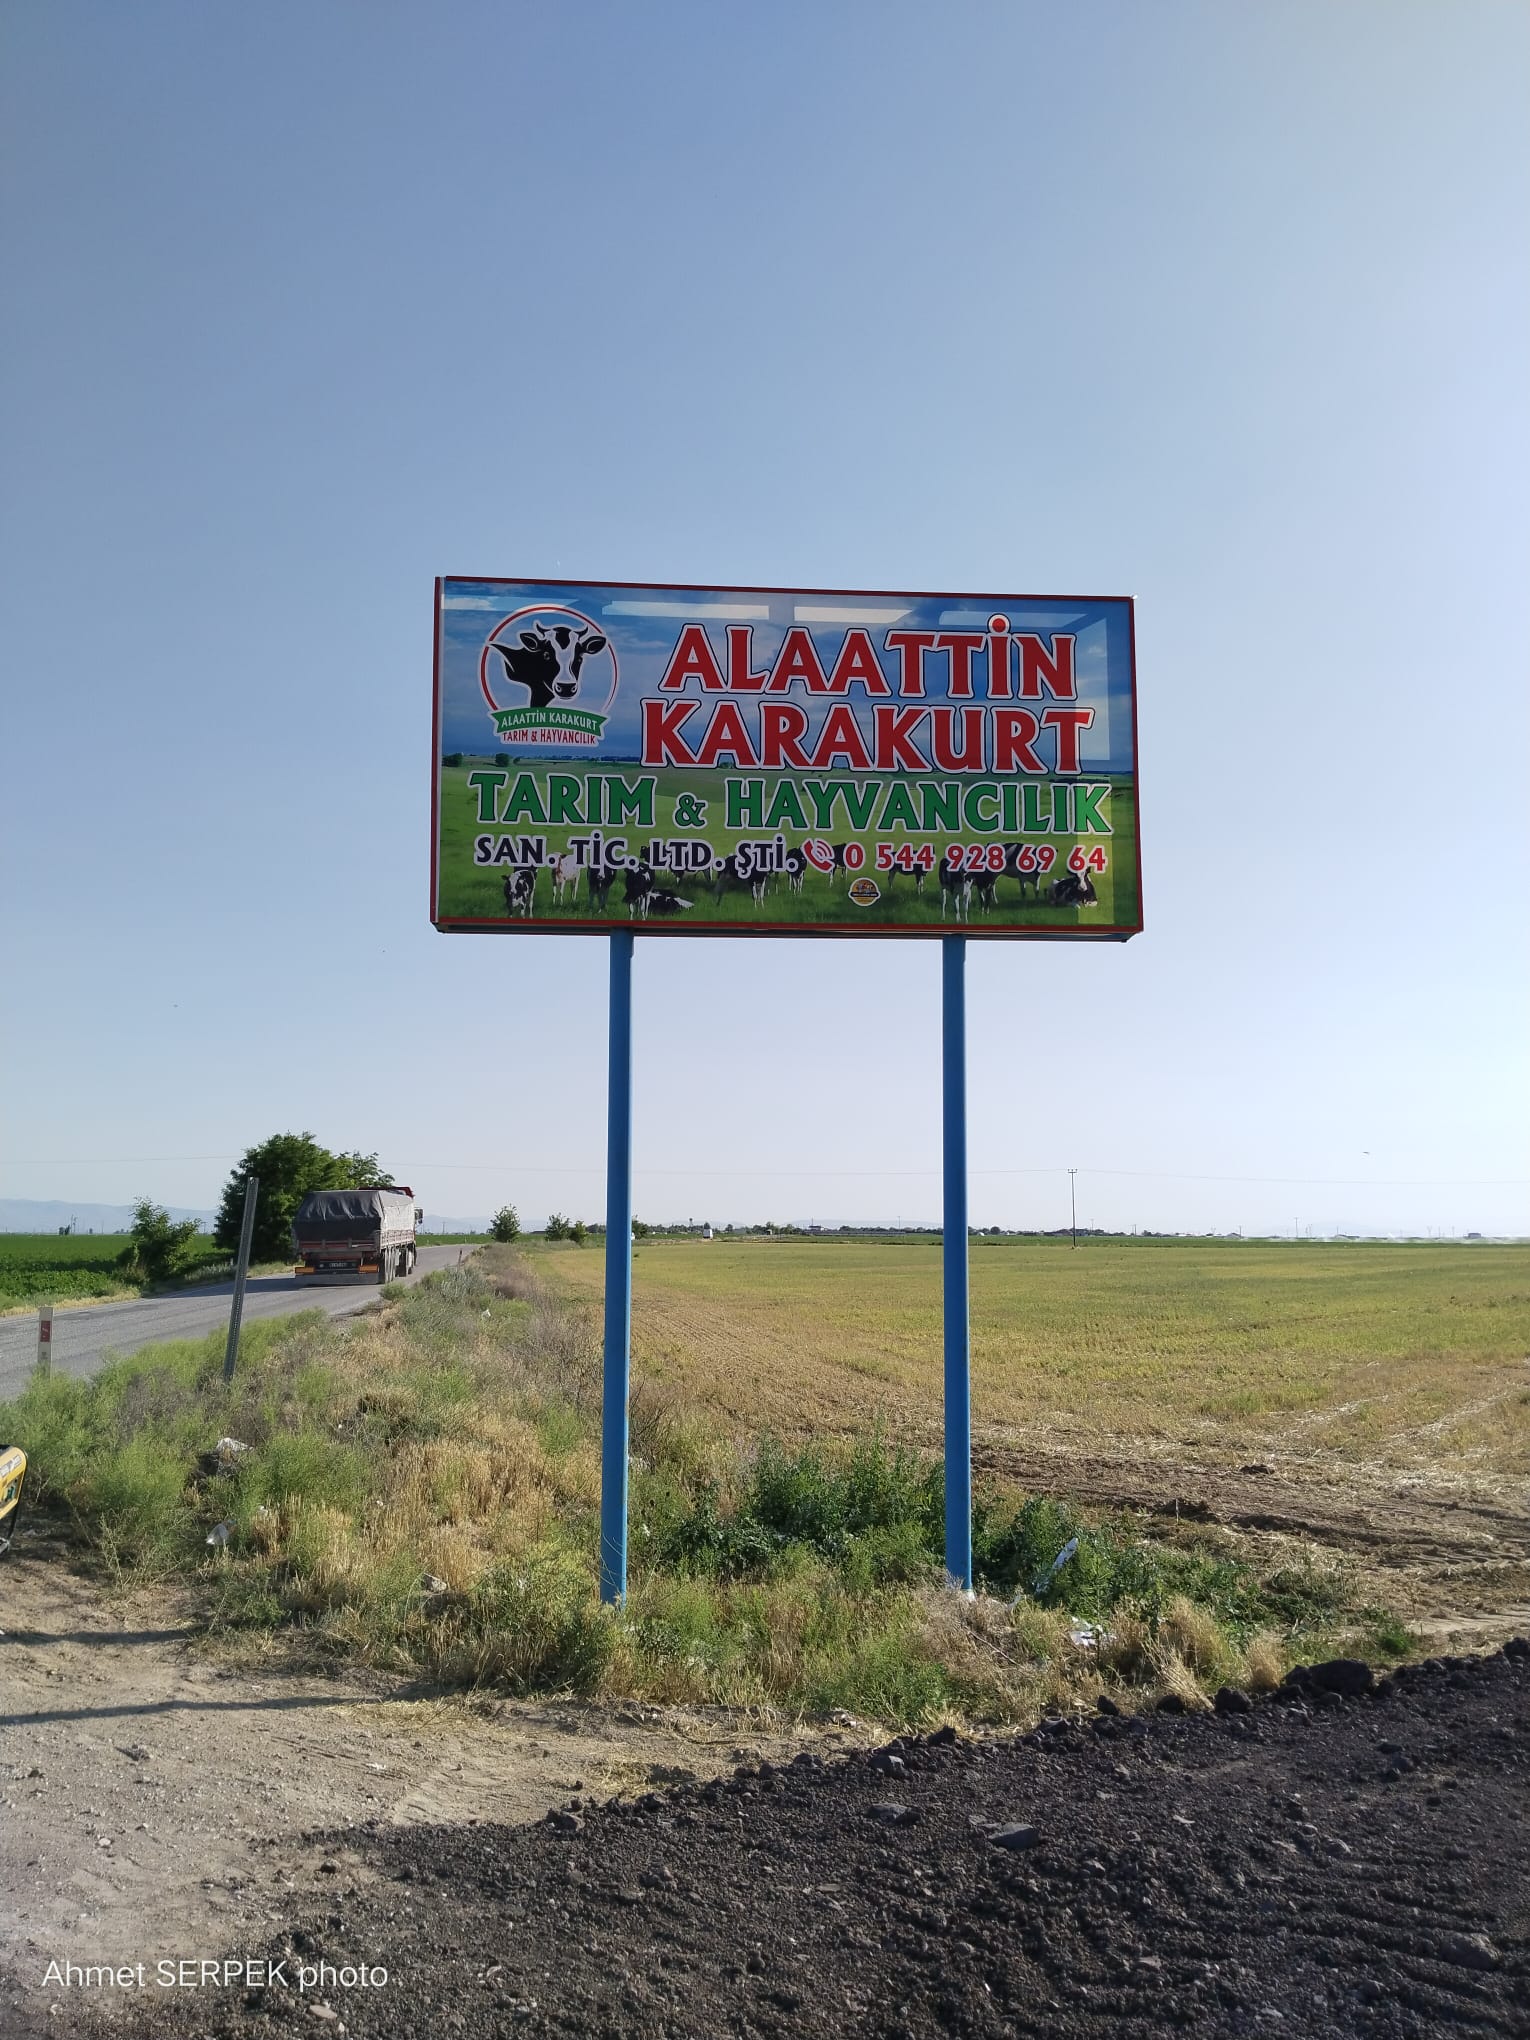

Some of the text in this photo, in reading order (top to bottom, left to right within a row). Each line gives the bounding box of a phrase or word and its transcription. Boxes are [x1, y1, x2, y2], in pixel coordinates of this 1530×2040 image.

[660, 616, 1076, 700] ALAATTİN
[501, 710, 597, 731] ALAATTİN KARAKURT
[503, 728, 596, 744] TARIM & HAYVANCILIK
[642, 699, 1094, 773] KARAKURT
[469, 773, 1112, 833] TARIM & HAYVANCILIK
[475, 832, 799, 877] SAN. TİC. LTD. ŞTİ.
[844, 844, 1106, 872] 0 544 928 69 64
